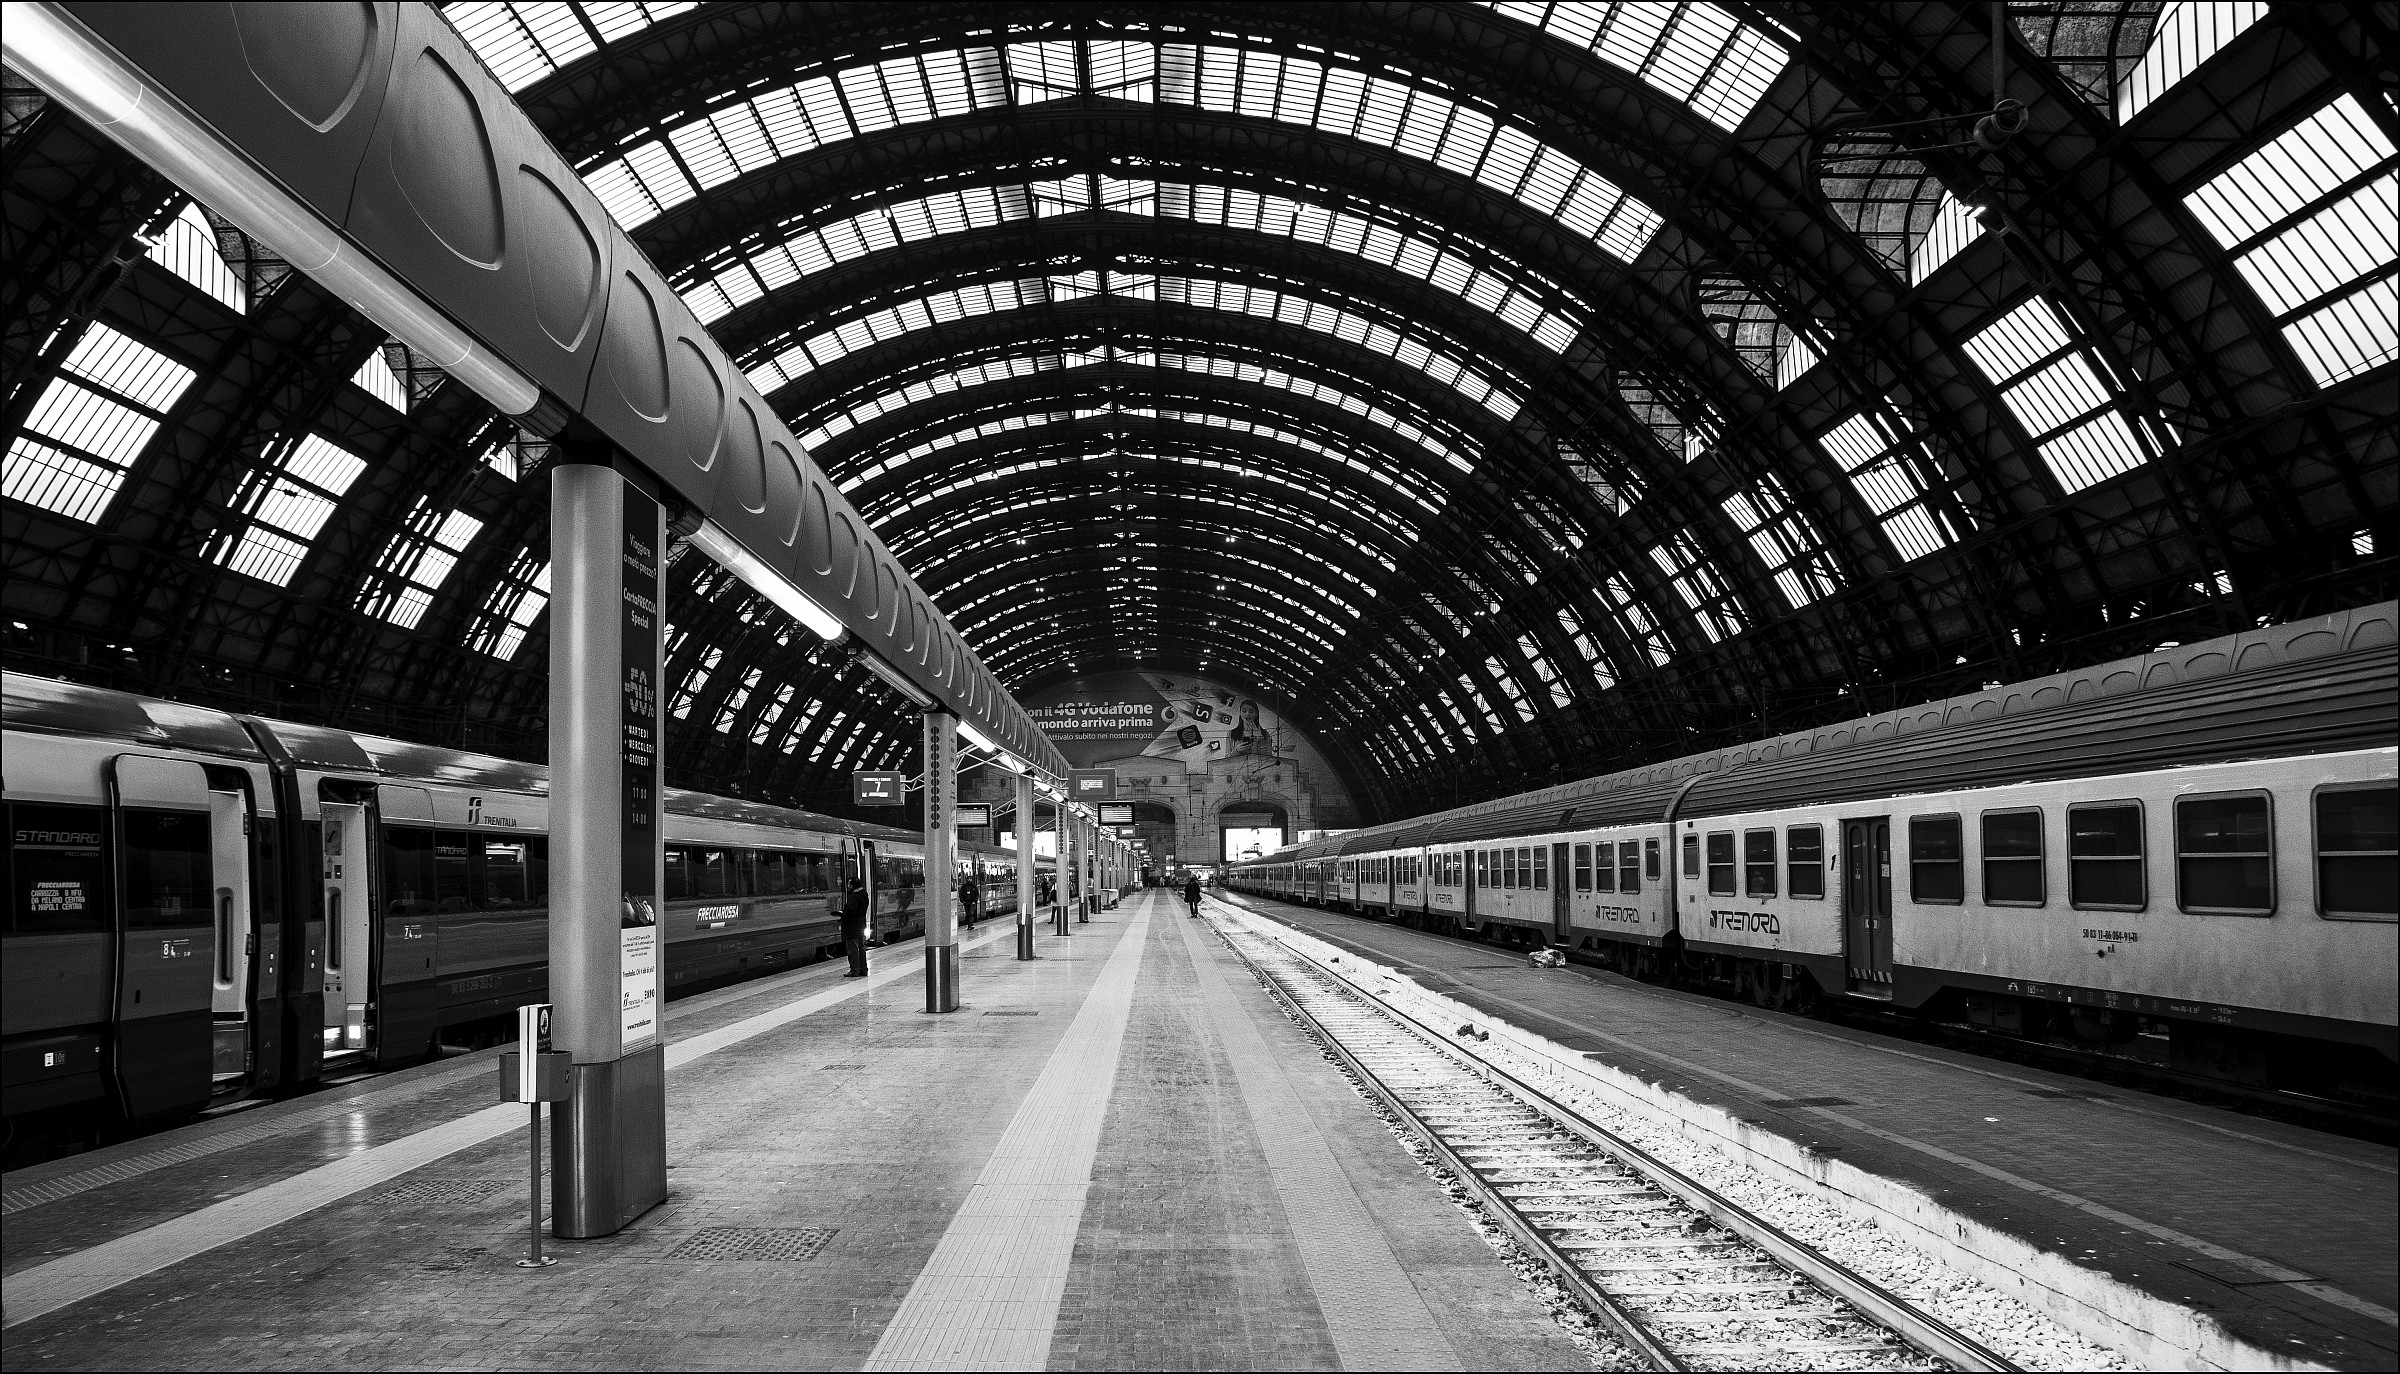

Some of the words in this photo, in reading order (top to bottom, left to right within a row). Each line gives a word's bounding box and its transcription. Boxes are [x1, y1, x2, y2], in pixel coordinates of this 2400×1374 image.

[631, 610, 649, 629] Special
[1054, 702, 1076, 716] 4G
[1078, 701, 1154, 716] Vodafone
[1037, 717, 1080, 730] mondo
[1081, 716, 1116, 728] arriva
[1118, 716, 1154, 730] prima
[1074, 732, 1096, 740] subito
[1097, 732, 1108, 740] nei
[1109, 731, 1129, 740] nostri
[1129, 731, 1155, 741] negozi.
[875, 781, 881, 793] 7
[484, 815, 517, 828] TRENITALIA
[15, 830, 101, 844] STANDARD
[696, 905, 740, 922] FRECCIAROSSA
[1600, 905, 1640, 924] TRENORD
[1718, 910, 1781, 935] TRENORD
[163, 943, 169, 956] 8
